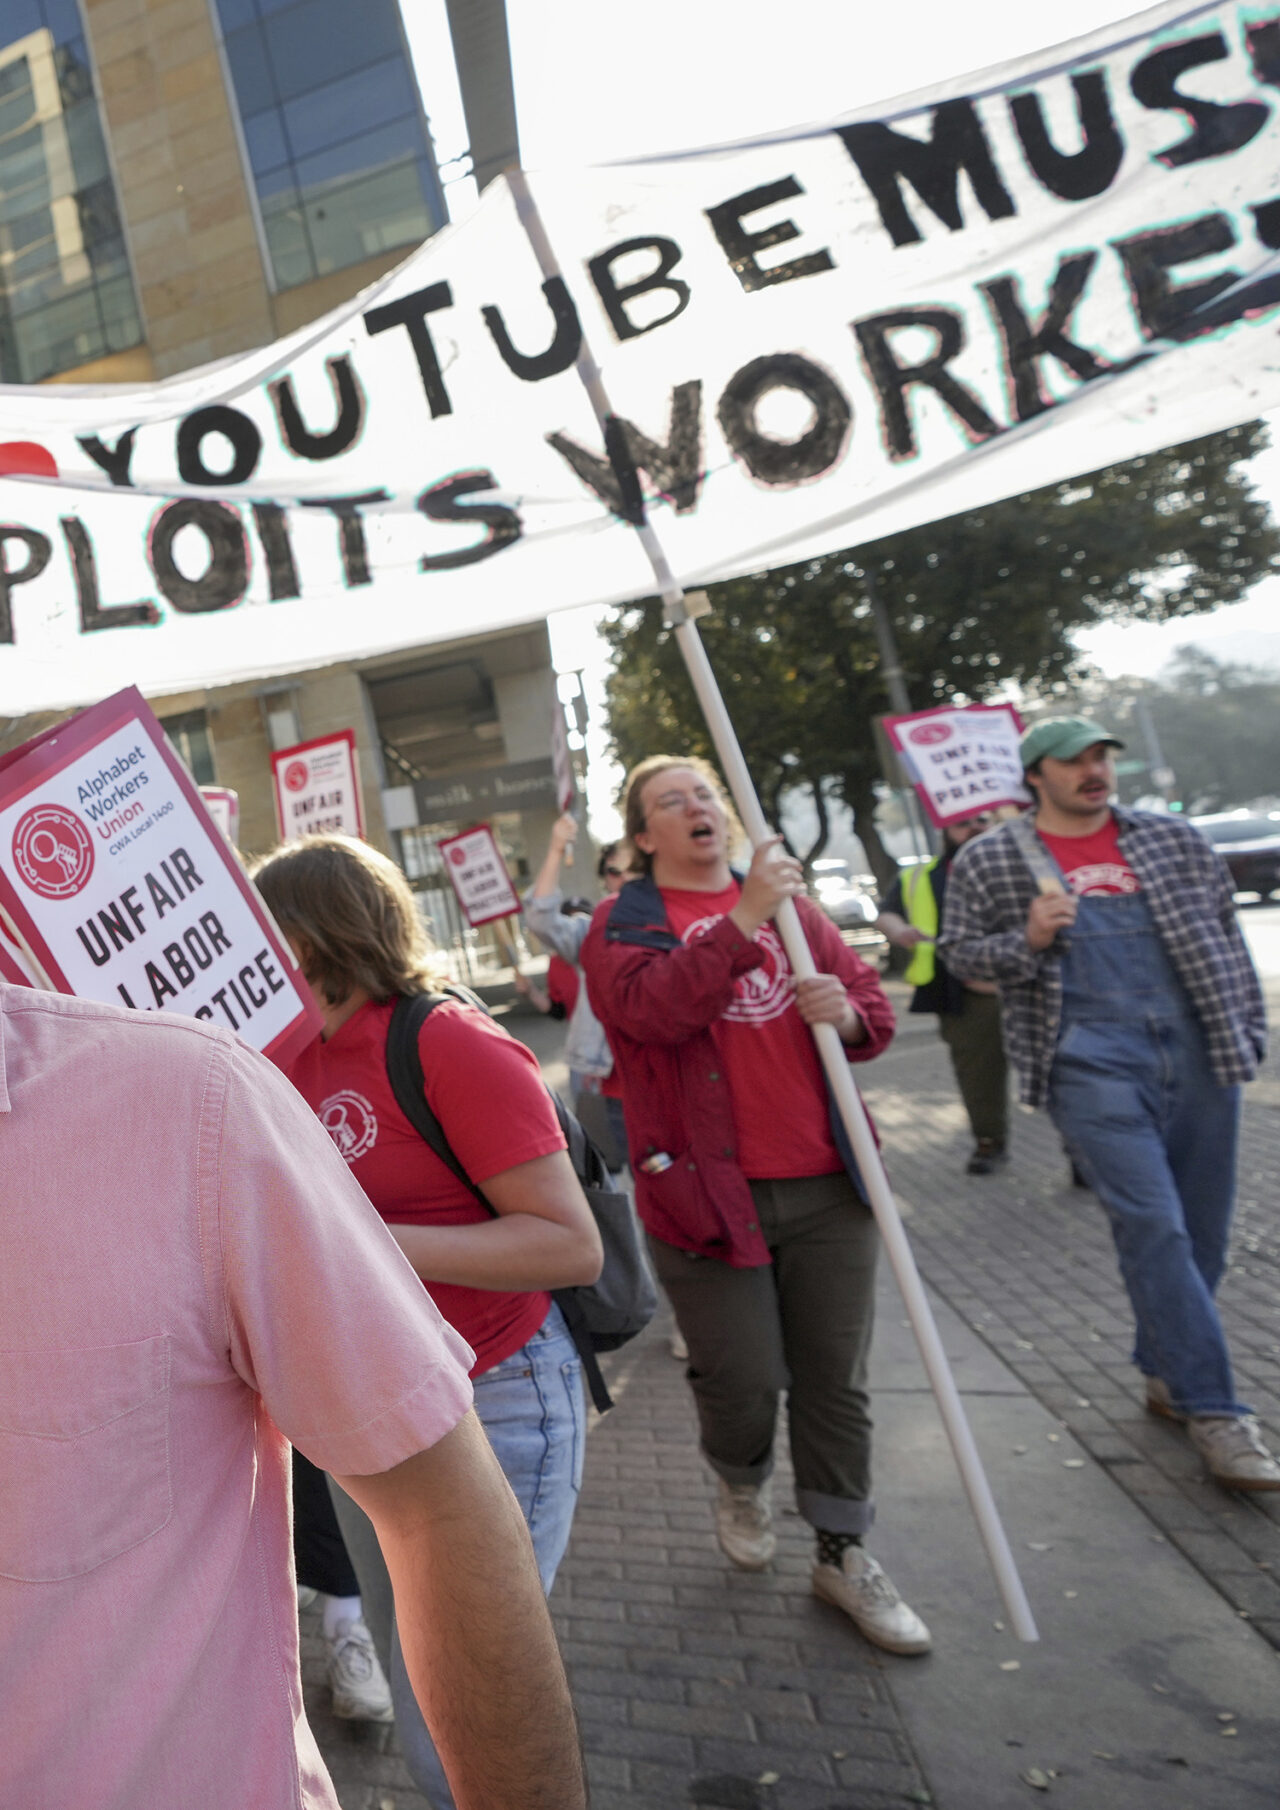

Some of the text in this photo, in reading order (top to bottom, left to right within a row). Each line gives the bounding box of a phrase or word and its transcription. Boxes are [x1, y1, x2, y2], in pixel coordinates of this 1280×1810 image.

[546, 197, 1280, 527] WORKE
[77, 745, 146, 804] Alphabet
[84, 770, 149, 822] Workers
[97, 801, 144, 840] Union
[109, 800, 175, 855] CWA Local 1400
[293, 789, 343, 818] UNFAIR
[75, 847, 204, 967] UNFAIR
[117, 910, 233, 1011] LABOR
